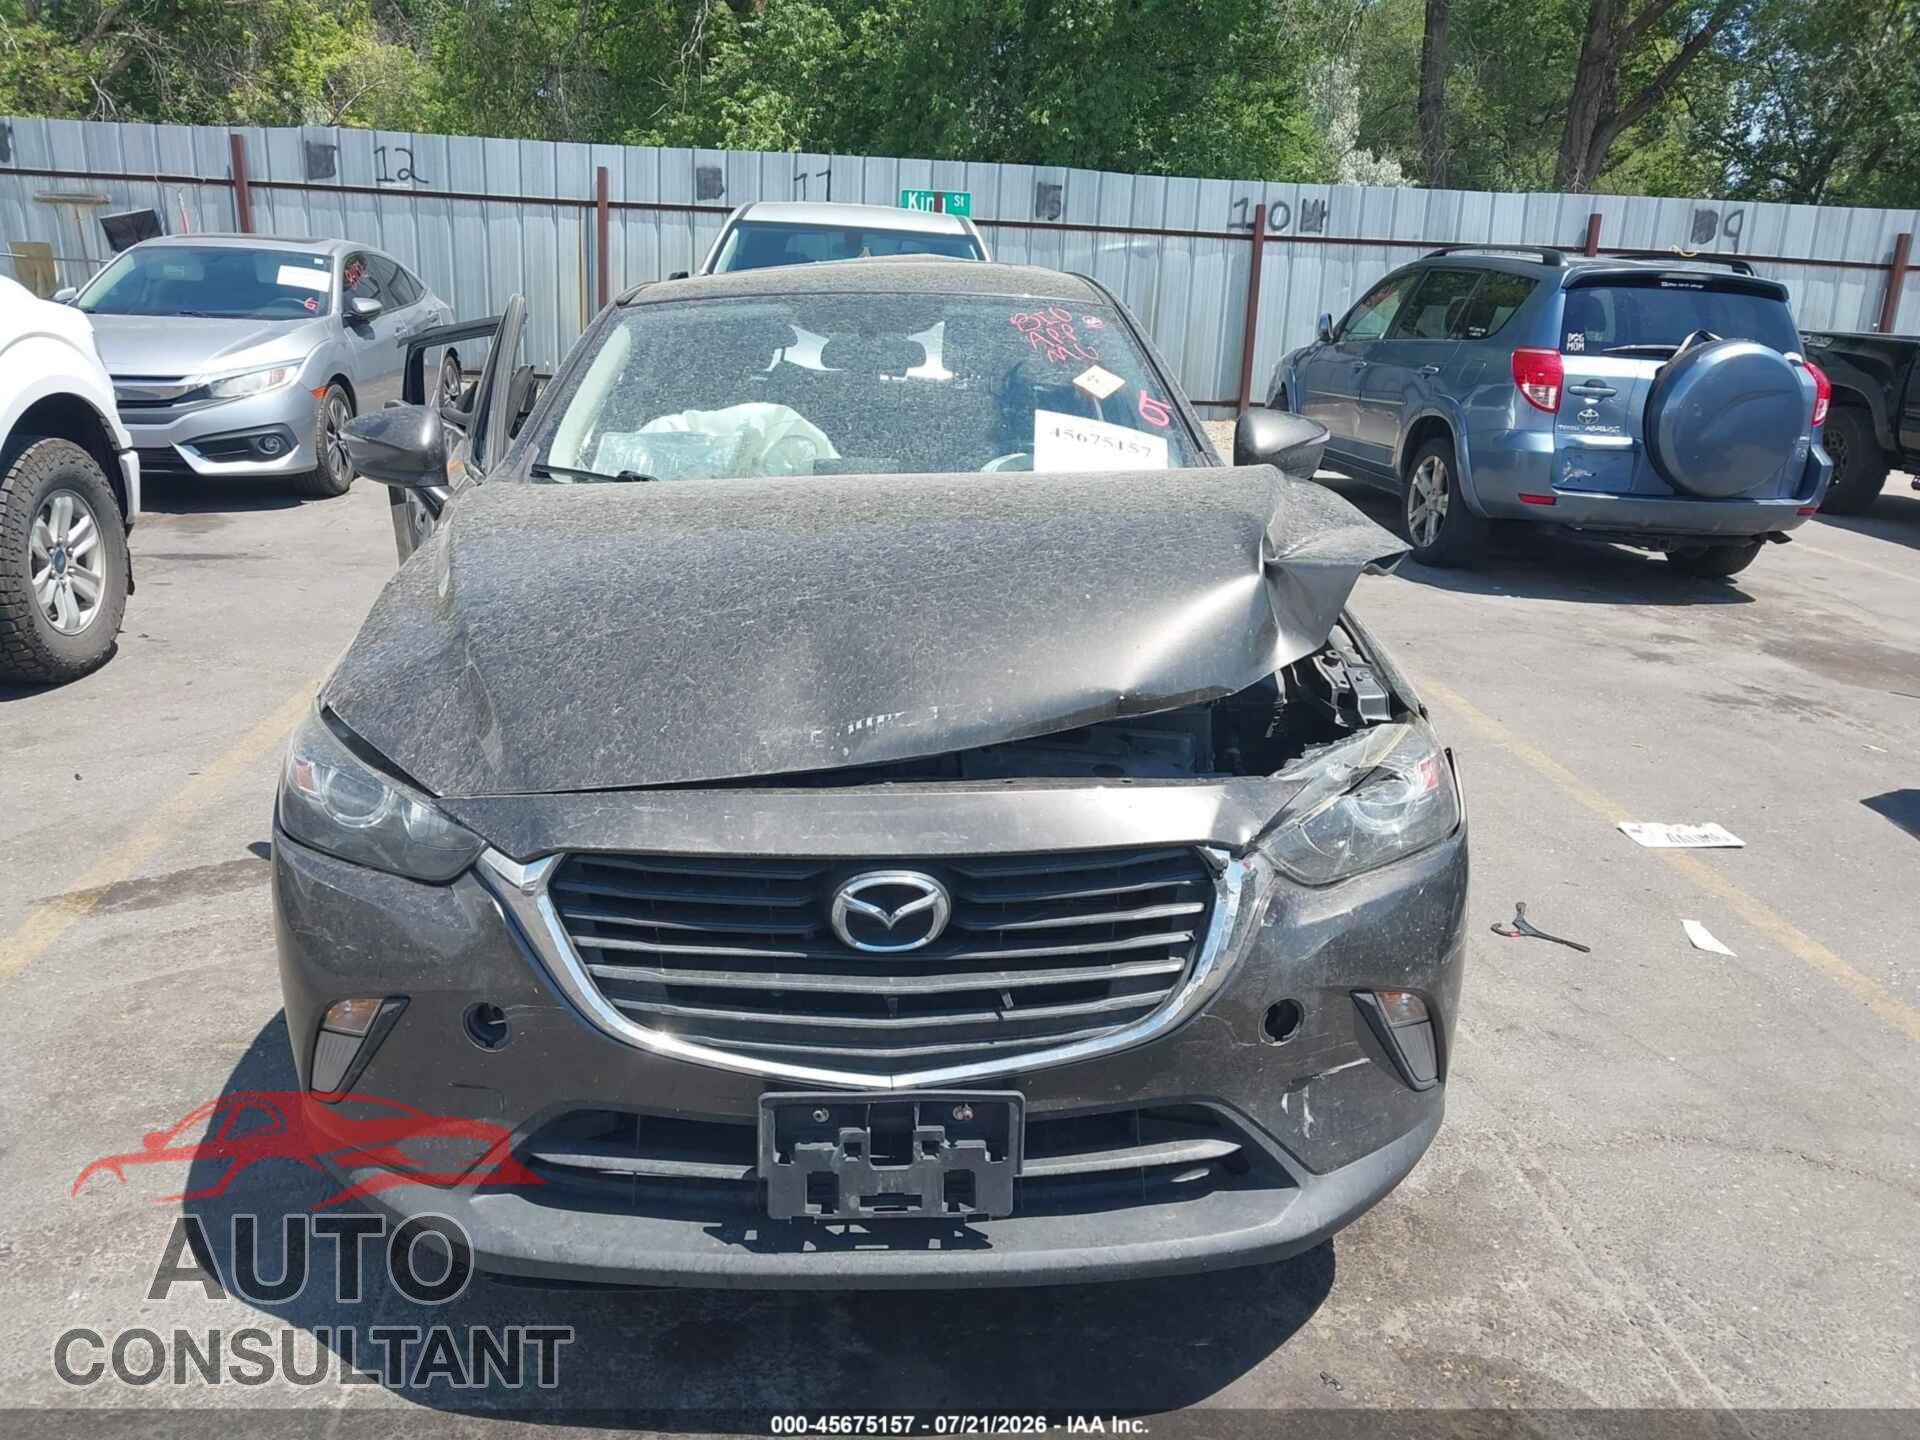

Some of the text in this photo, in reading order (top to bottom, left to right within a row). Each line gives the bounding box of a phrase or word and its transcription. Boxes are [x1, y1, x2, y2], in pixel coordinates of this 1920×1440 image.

[374, 145, 429, 183] 12
[908, 191, 965, 214] Kin St
[1567, 332, 1585, 343] DOG
[1566, 342, 1585, 351] MOM
